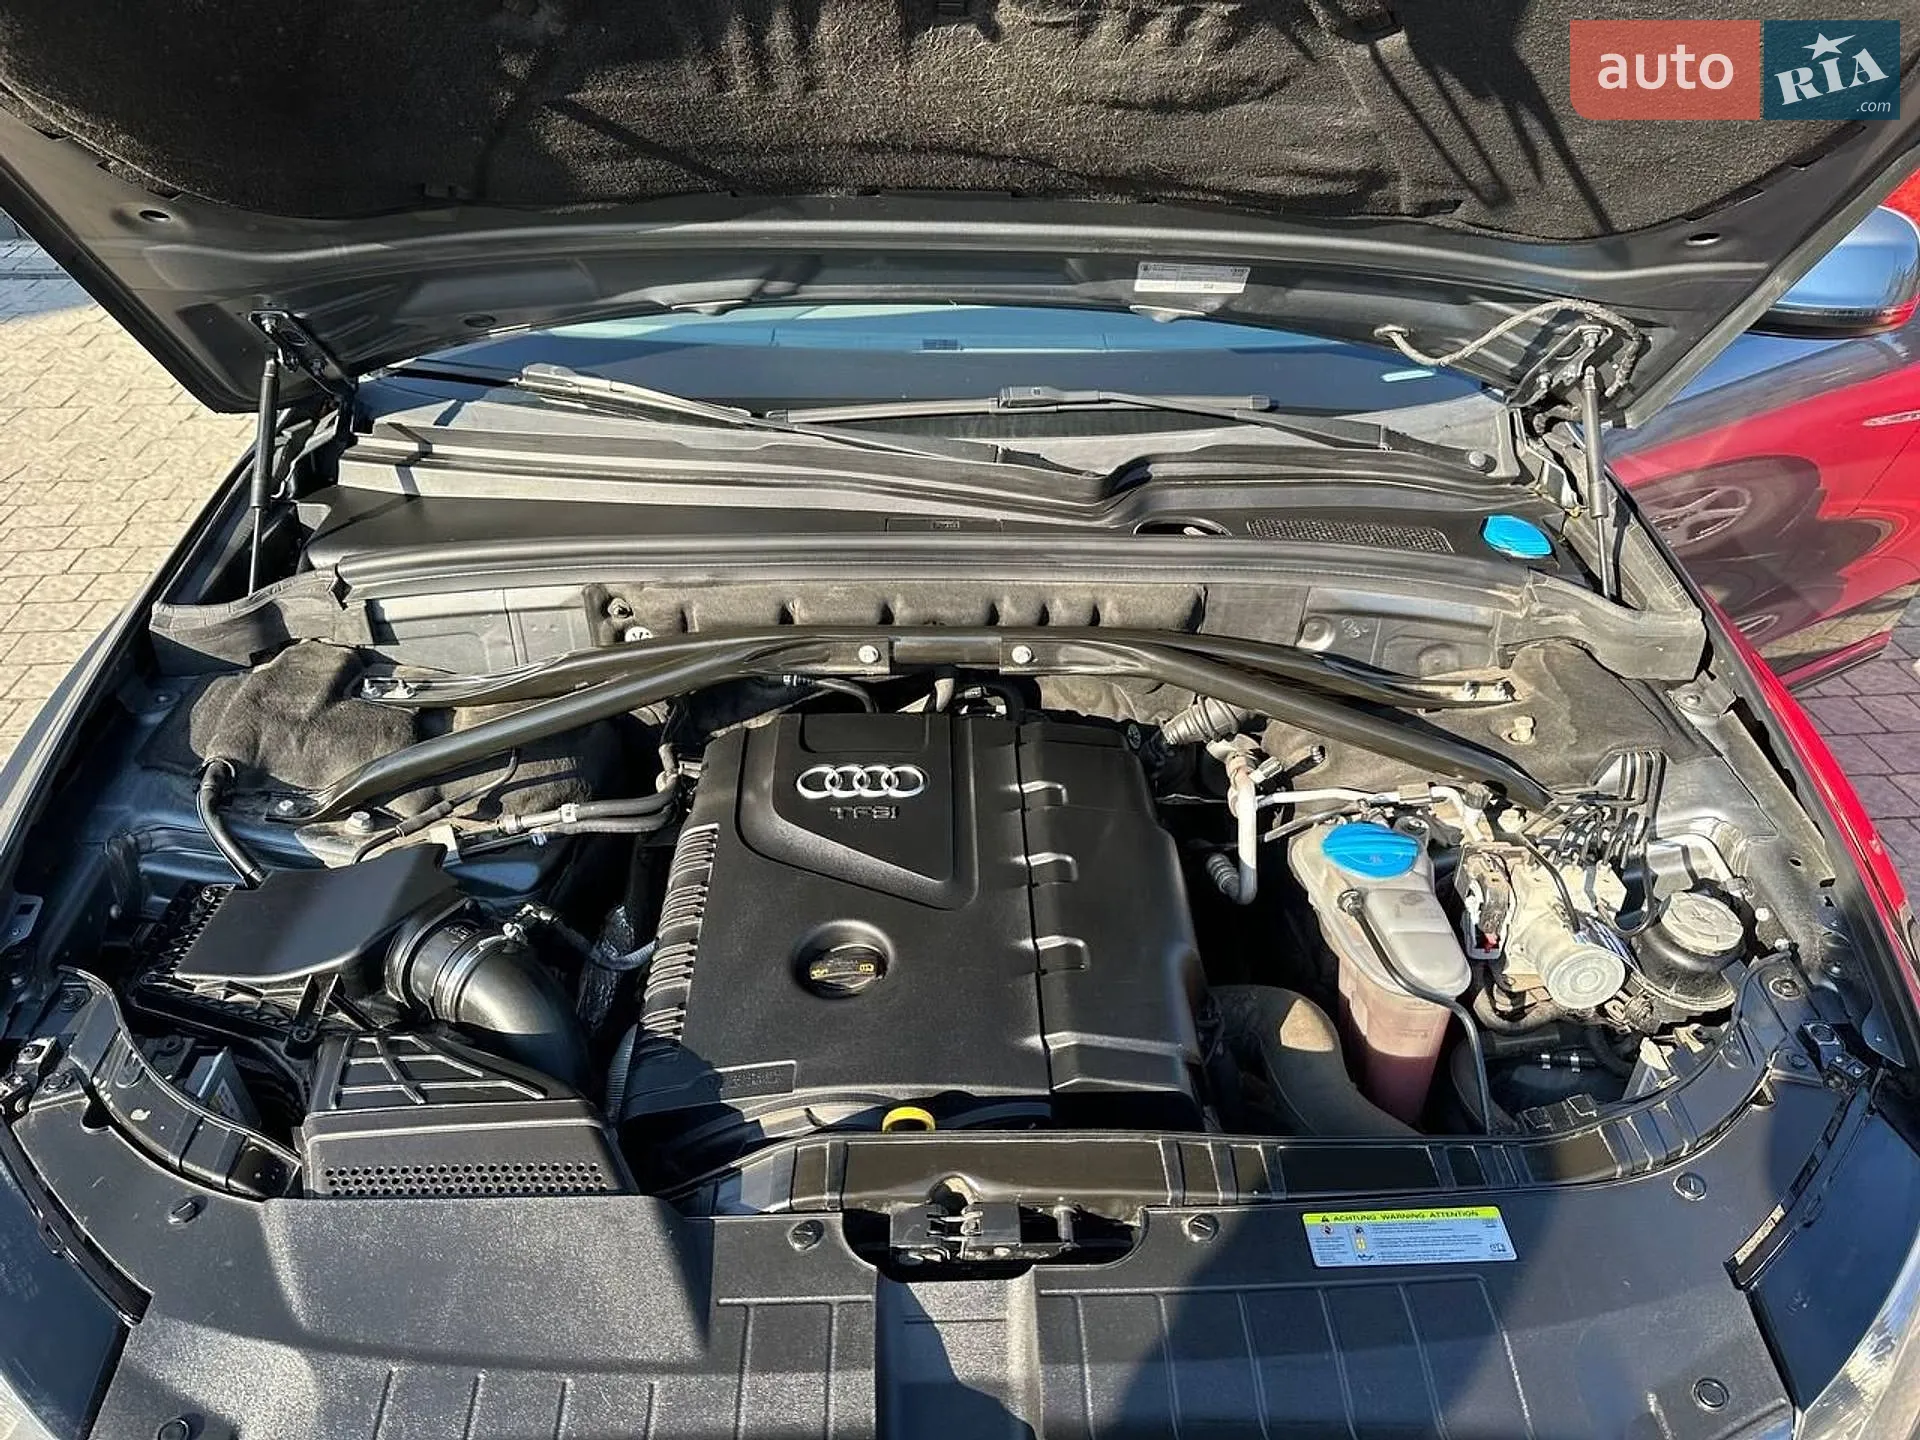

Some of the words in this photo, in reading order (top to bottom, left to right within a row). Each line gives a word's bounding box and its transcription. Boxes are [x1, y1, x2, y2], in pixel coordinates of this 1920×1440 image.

[1333, 1214, 1377, 1222] ACHTUNG
[1381, 1212, 1425, 1220] WARNING
[1429, 1209, 1479, 1218] ATTENTION
